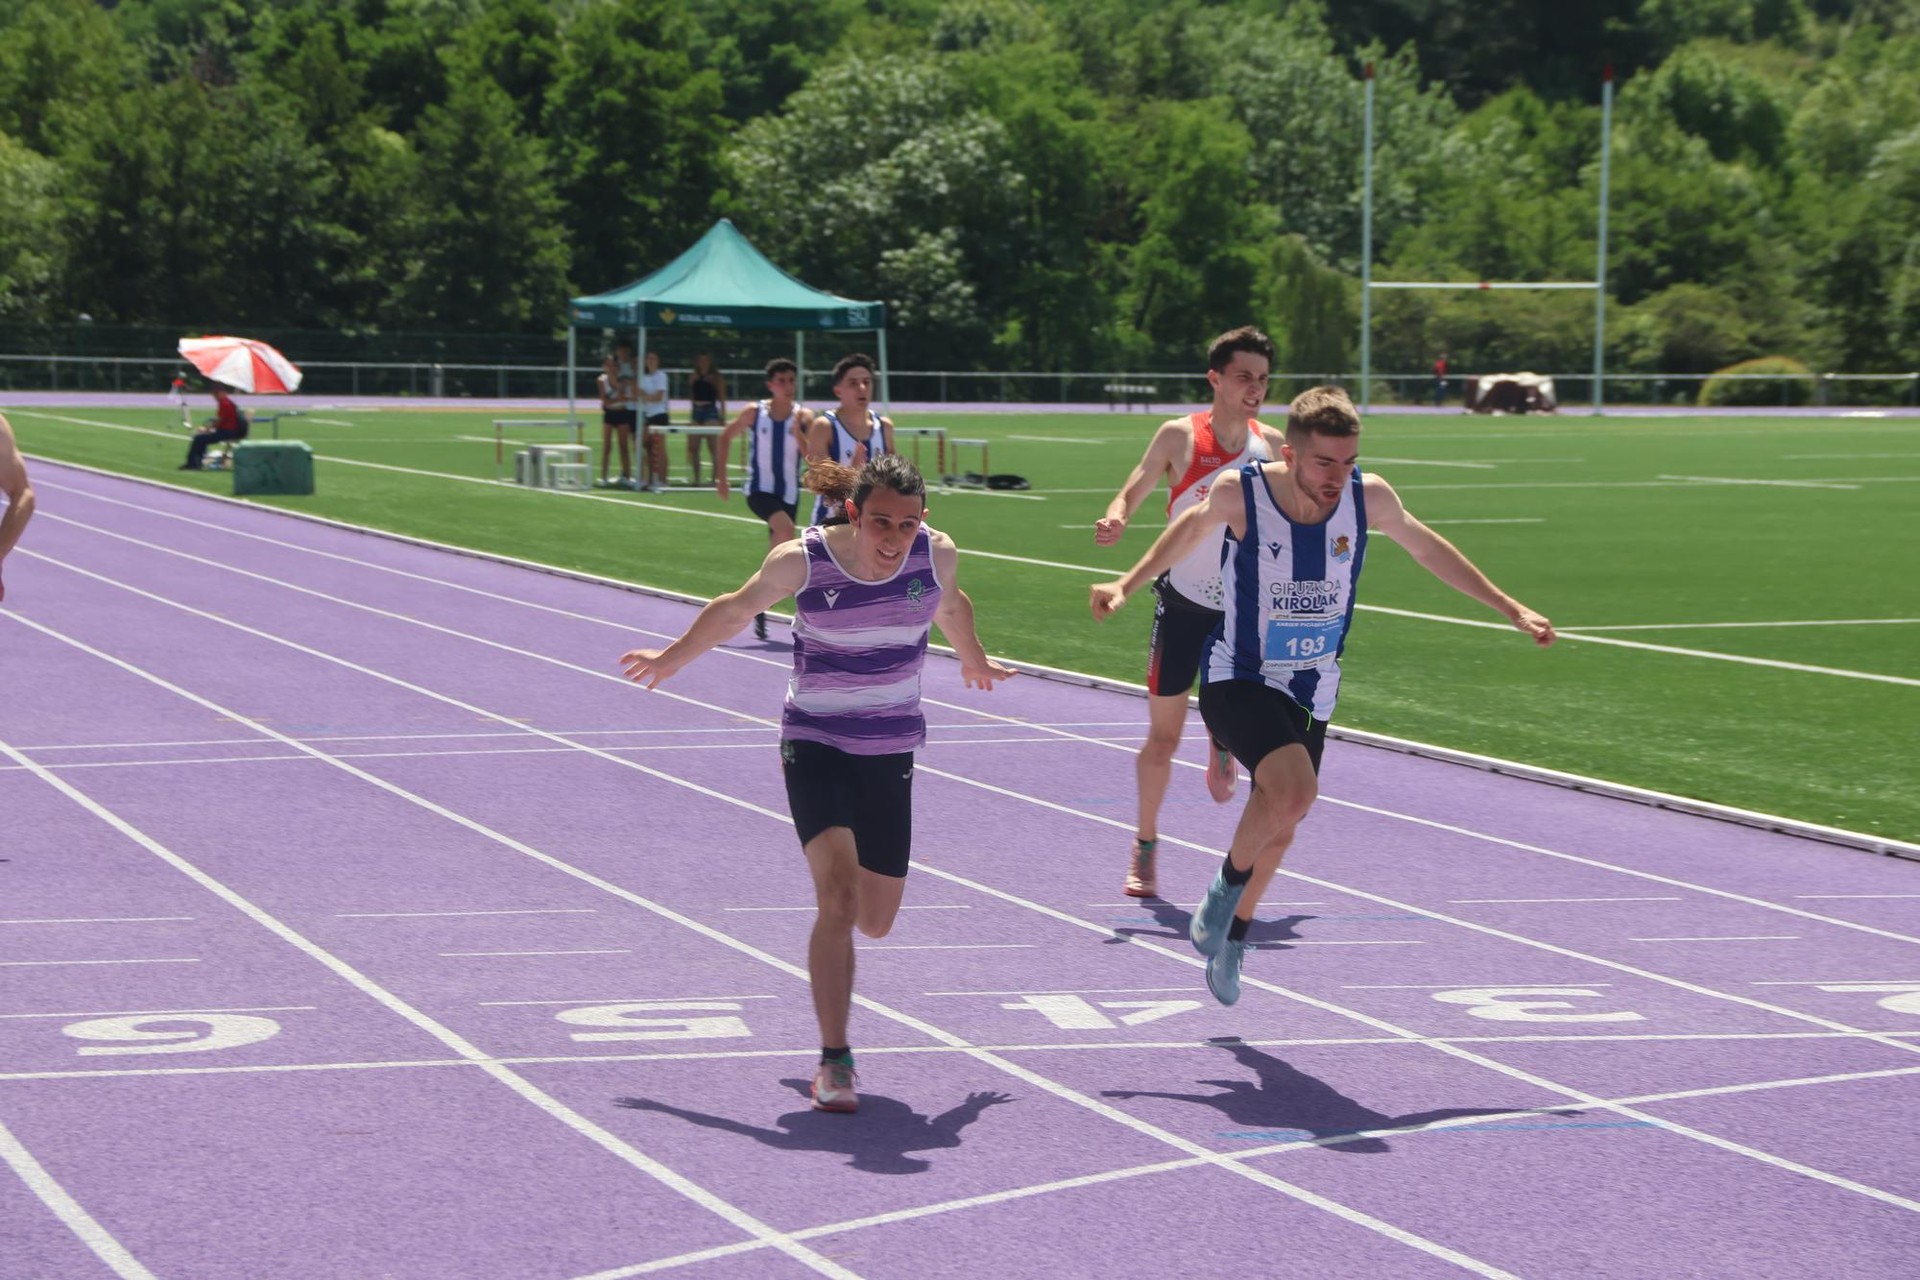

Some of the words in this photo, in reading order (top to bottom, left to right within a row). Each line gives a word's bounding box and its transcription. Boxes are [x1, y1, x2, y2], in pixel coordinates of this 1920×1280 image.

[1270, 579, 1342, 595] GIPUZKOA
[1273, 593, 1338, 610] KIROLAK
[1286, 635, 1326, 657] 193
[1000, 994, 1203, 1030] 4
[1431, 988, 1646, 1022] 3
[62, 1013, 281, 1056] 6
[555, 1002, 753, 1043] 5
